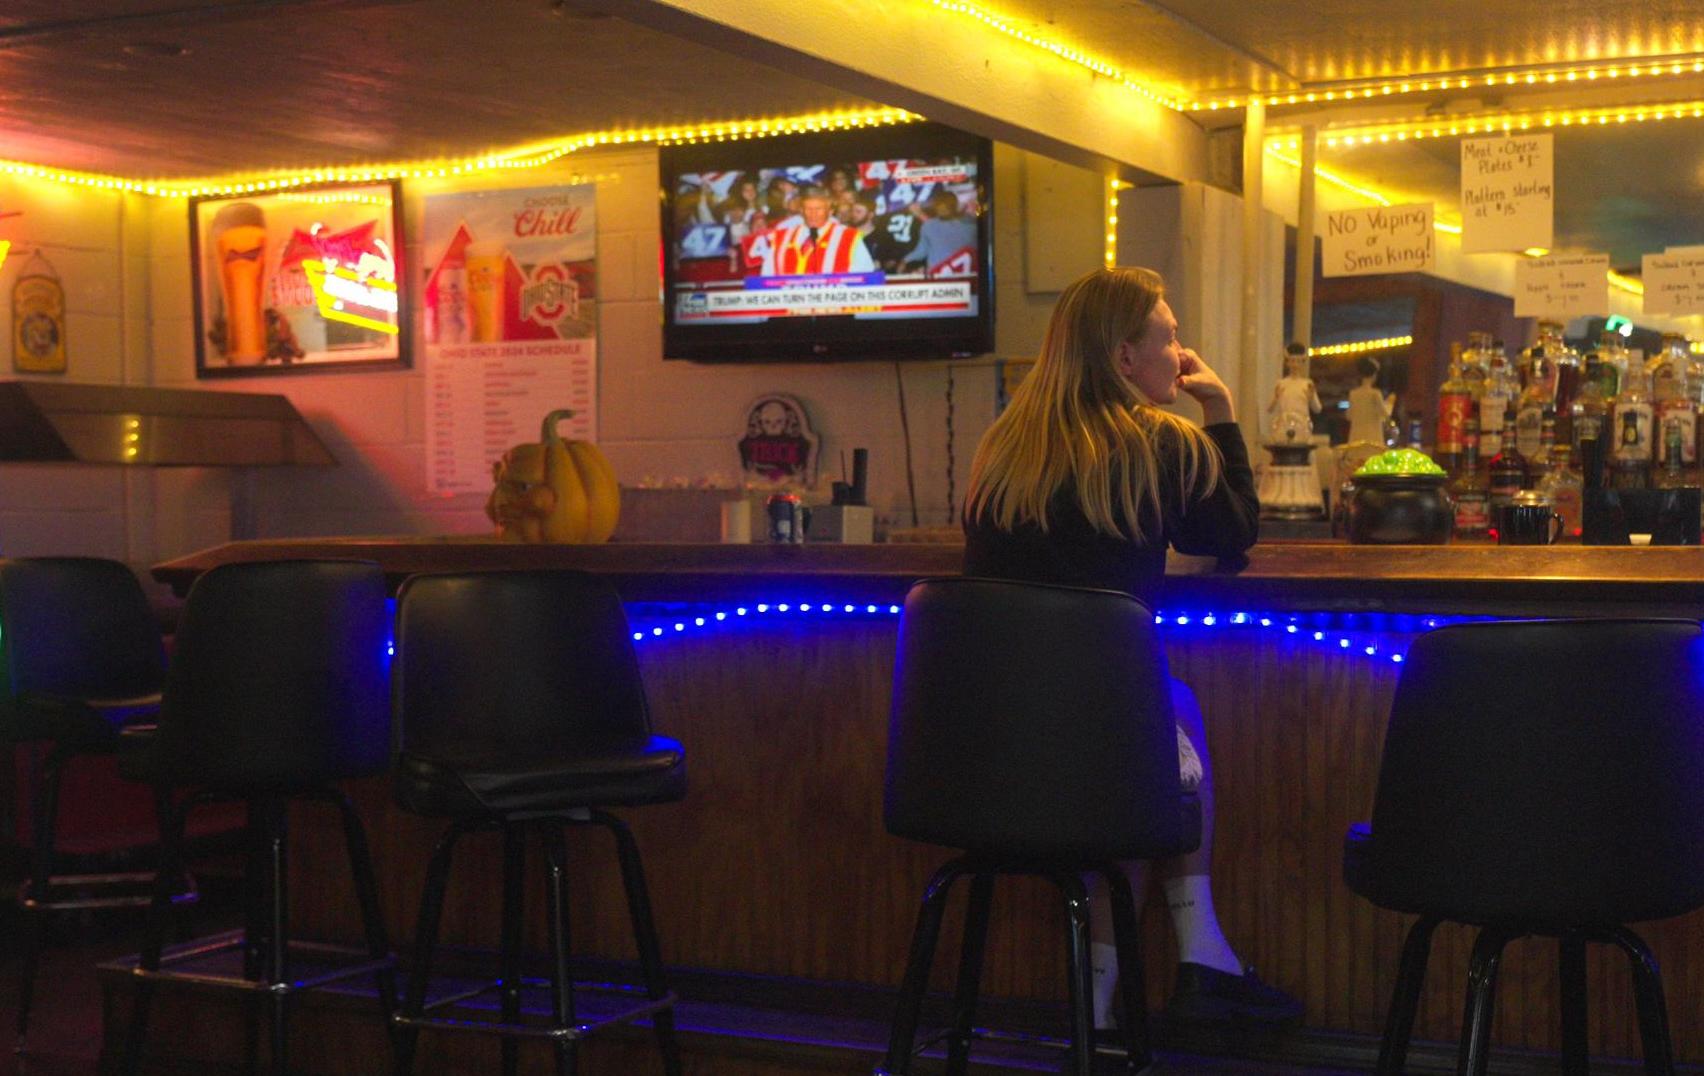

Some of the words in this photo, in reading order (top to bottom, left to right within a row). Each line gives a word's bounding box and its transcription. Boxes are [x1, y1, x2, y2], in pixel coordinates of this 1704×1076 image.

[1478, 160, 1513, 174] Plates
[514, 206, 583, 238] Chill
[1328, 212, 1357, 236] NO
[1367, 209, 1426, 236] Vaping
[682, 225, 727, 256] 47
[1344, 236, 1431, 272] Smoking!
[1366, 234, 1378, 247] or
[761, 294, 782, 305] CAN
[782, 294, 805, 304] TURN
[806, 293, 824, 303] THE
[825, 292, 849, 303] PAGE
[849, 292, 866, 302] ON
[867, 291, 886, 301] THIS
[887, 289, 929, 300] CORRUPT
[931, 288, 964, 298] ADMIN
